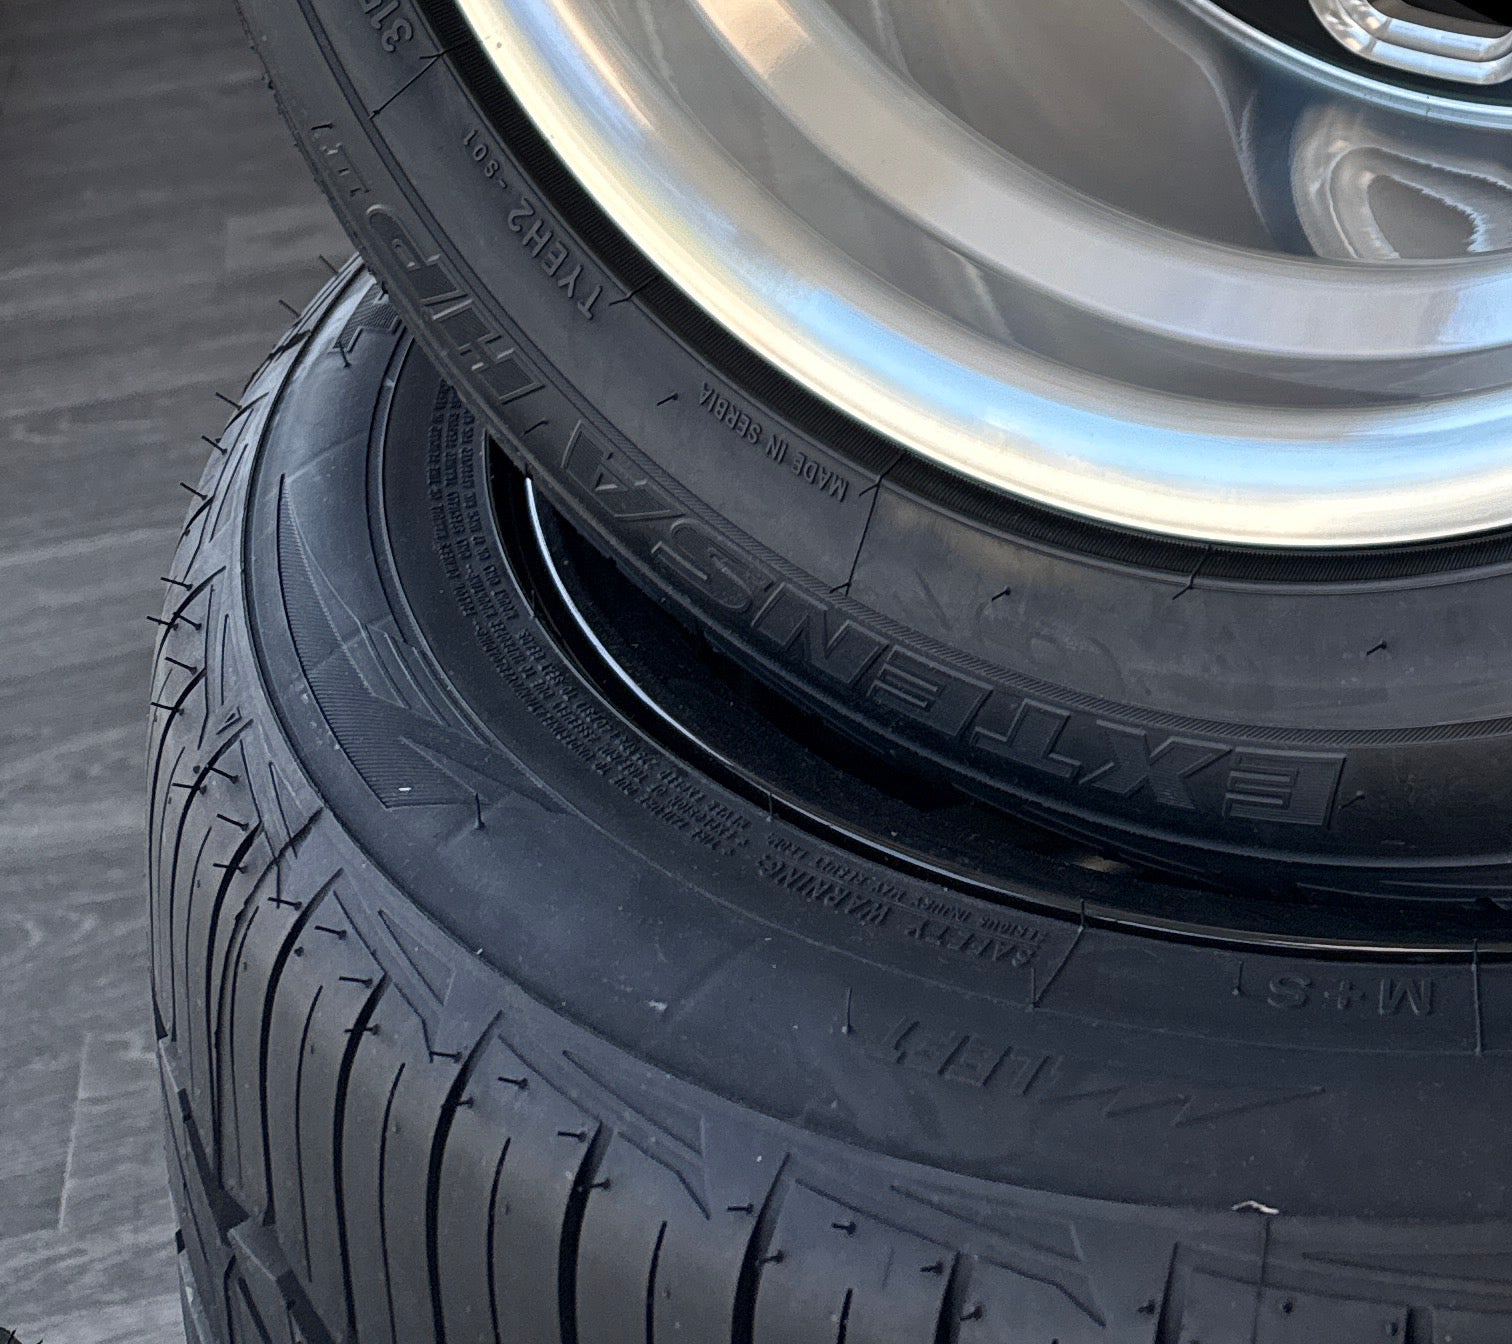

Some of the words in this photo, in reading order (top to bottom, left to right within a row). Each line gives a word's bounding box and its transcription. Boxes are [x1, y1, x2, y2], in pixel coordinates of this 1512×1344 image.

[500, 192, 611, 322] TYEH2
[692, 379, 765, 448] SERBIA
[761, 429, 790, 465] IN
[787, 447, 853, 505] MADE
[560, 419, 1350, 827] EXTENSA
